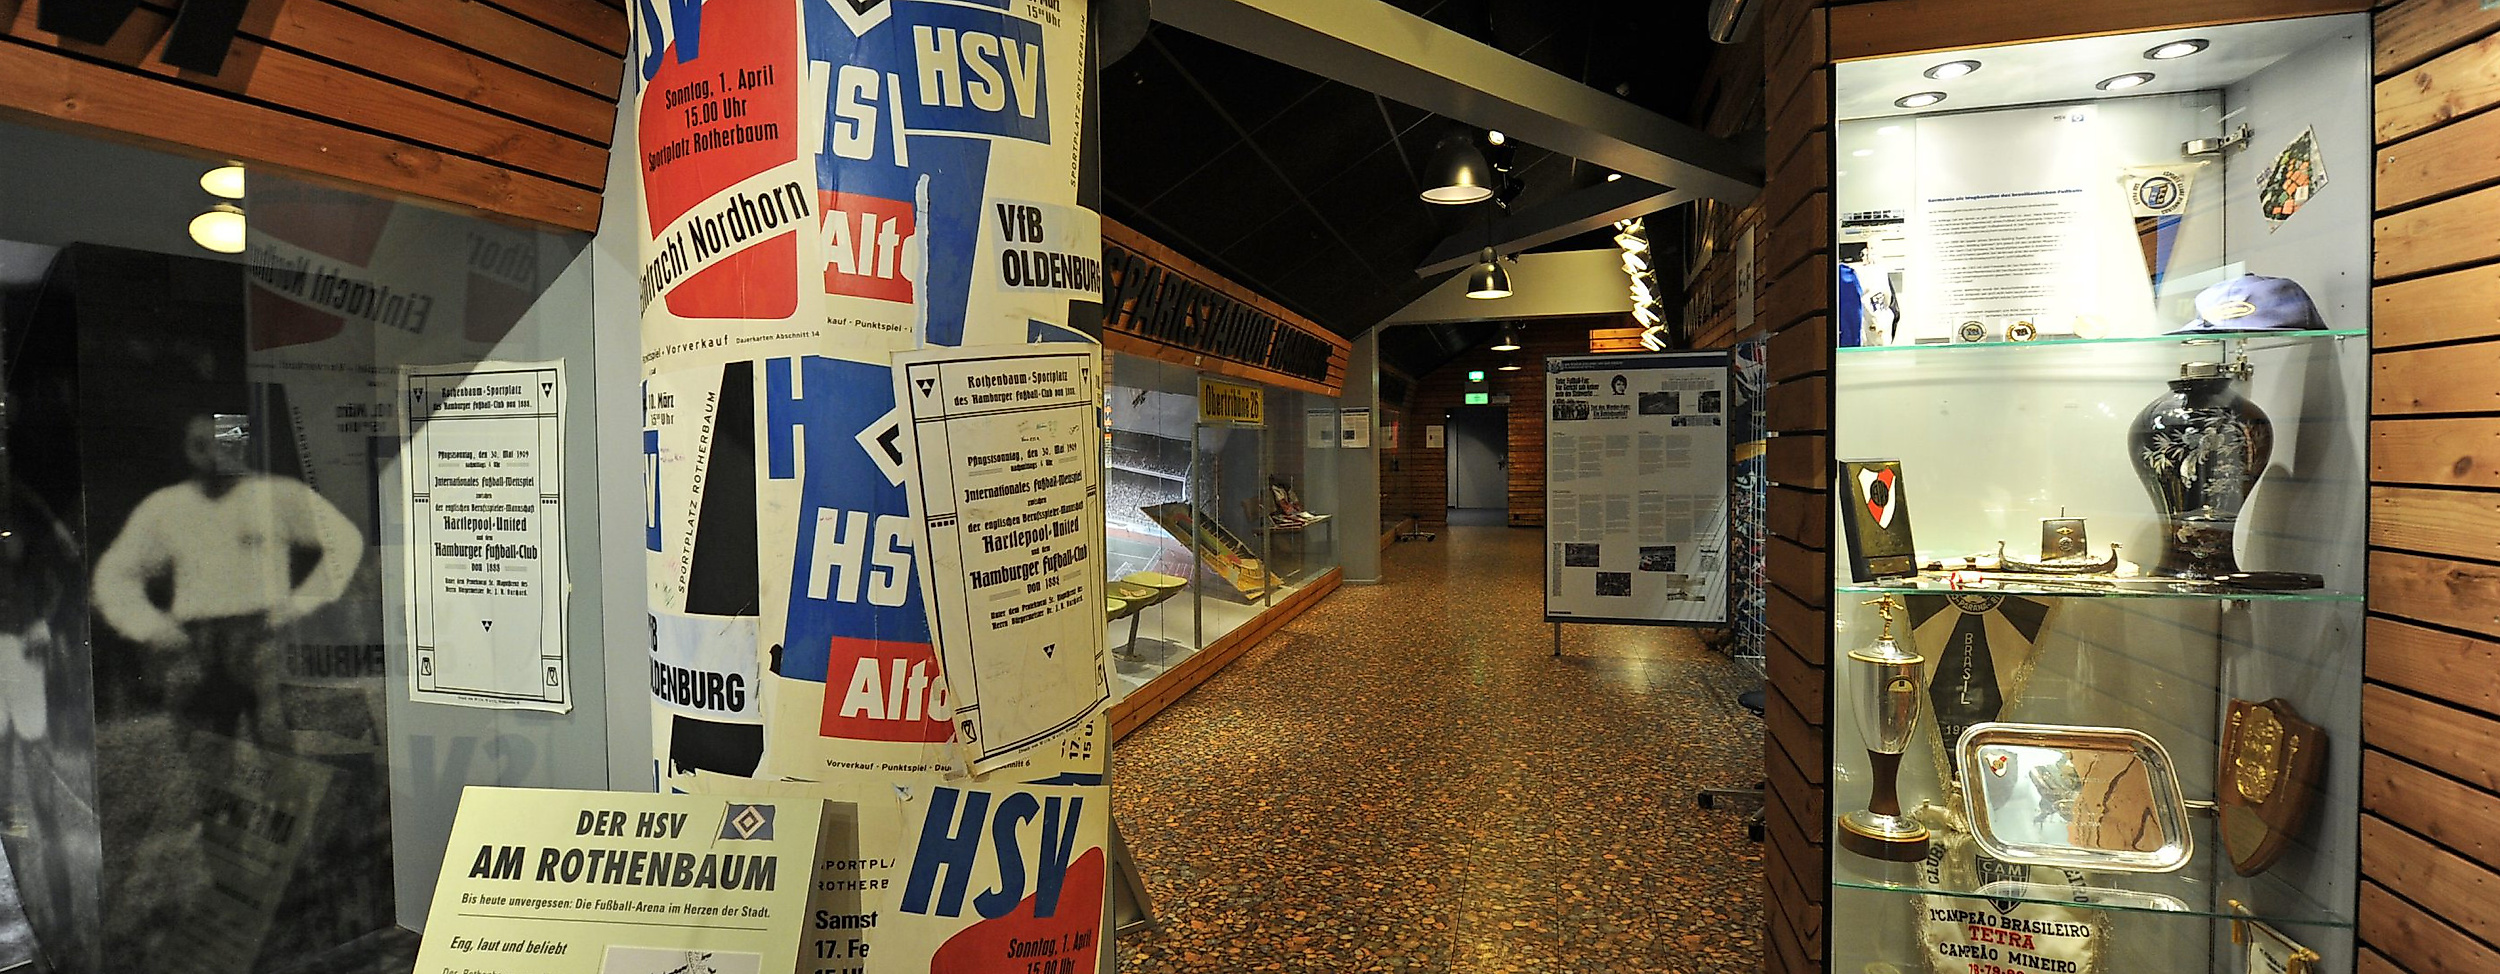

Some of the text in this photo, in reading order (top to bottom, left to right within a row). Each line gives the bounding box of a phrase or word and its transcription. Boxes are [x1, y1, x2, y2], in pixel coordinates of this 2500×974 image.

[1046, 11, 1061, 28] Uhr
[913, 25, 1039, 119] HSV
[664, 64, 774, 110] Sonntag, 1. April
[684, 98, 747, 129] 15.00 Uhr
[648, 122, 779, 172] Sportplatz Rotherbaum
[688, 181, 811, 264] Nordhorn
[996, 203, 1043, 244] VfB
[855, 319, 902, 333] Punktspiel
[665, 334, 728, 356] Vorverkauf
[775, 331, 810, 341] Abschnitt
[811, 330, 820, 338] 14
[658, 391, 674, 409] März
[954, 395, 969, 407] des
[972, 393, 1013, 405] Hamburger
[661, 413, 674, 425] Uhr
[1027, 448, 1039, 459] den
[679, 390, 716, 594] SPORTPLATZ ROTHERBAUM
[443, 515, 528, 532] Hartlepool-United
[967, 520, 981, 533] der
[984, 515, 1021, 531] englischen
[982, 516, 1079, 553] Hartlepool-United
[434, 542, 538, 561] Hamburger Fußball-Club
[969, 559, 1040, 589] Hamburger
[1960, 632, 1974, 705] BRASIL
[826, 759, 874, 771] Vorverkauf
[881, 763, 928, 773] Punktspiel
[1025, 759, 1031, 768] 6
[576, 809, 688, 840] DER HSV
[900, 786, 1084, 919] HSV
[468, 844, 778, 892] AM ROTHENBAUM
[1982, 862, 2022, 876] CAM
[461, 893, 771, 918] Bis heute unvergessen: Die Fußball-Arena im Herzen der Stadt.
[1968, 925, 2035, 950] TETRA
[2000, 915, 2091, 938] BRASILEIRO
[450, 936, 568, 955] Eng, laut und beliebt
[815, 938, 870, 959] 17. Fe
[1063, 933, 1070, 953] 1.
[1073, 928, 1092, 951] April
[1939, 942, 2077, 974] CAMPEÃO MINEIRO
